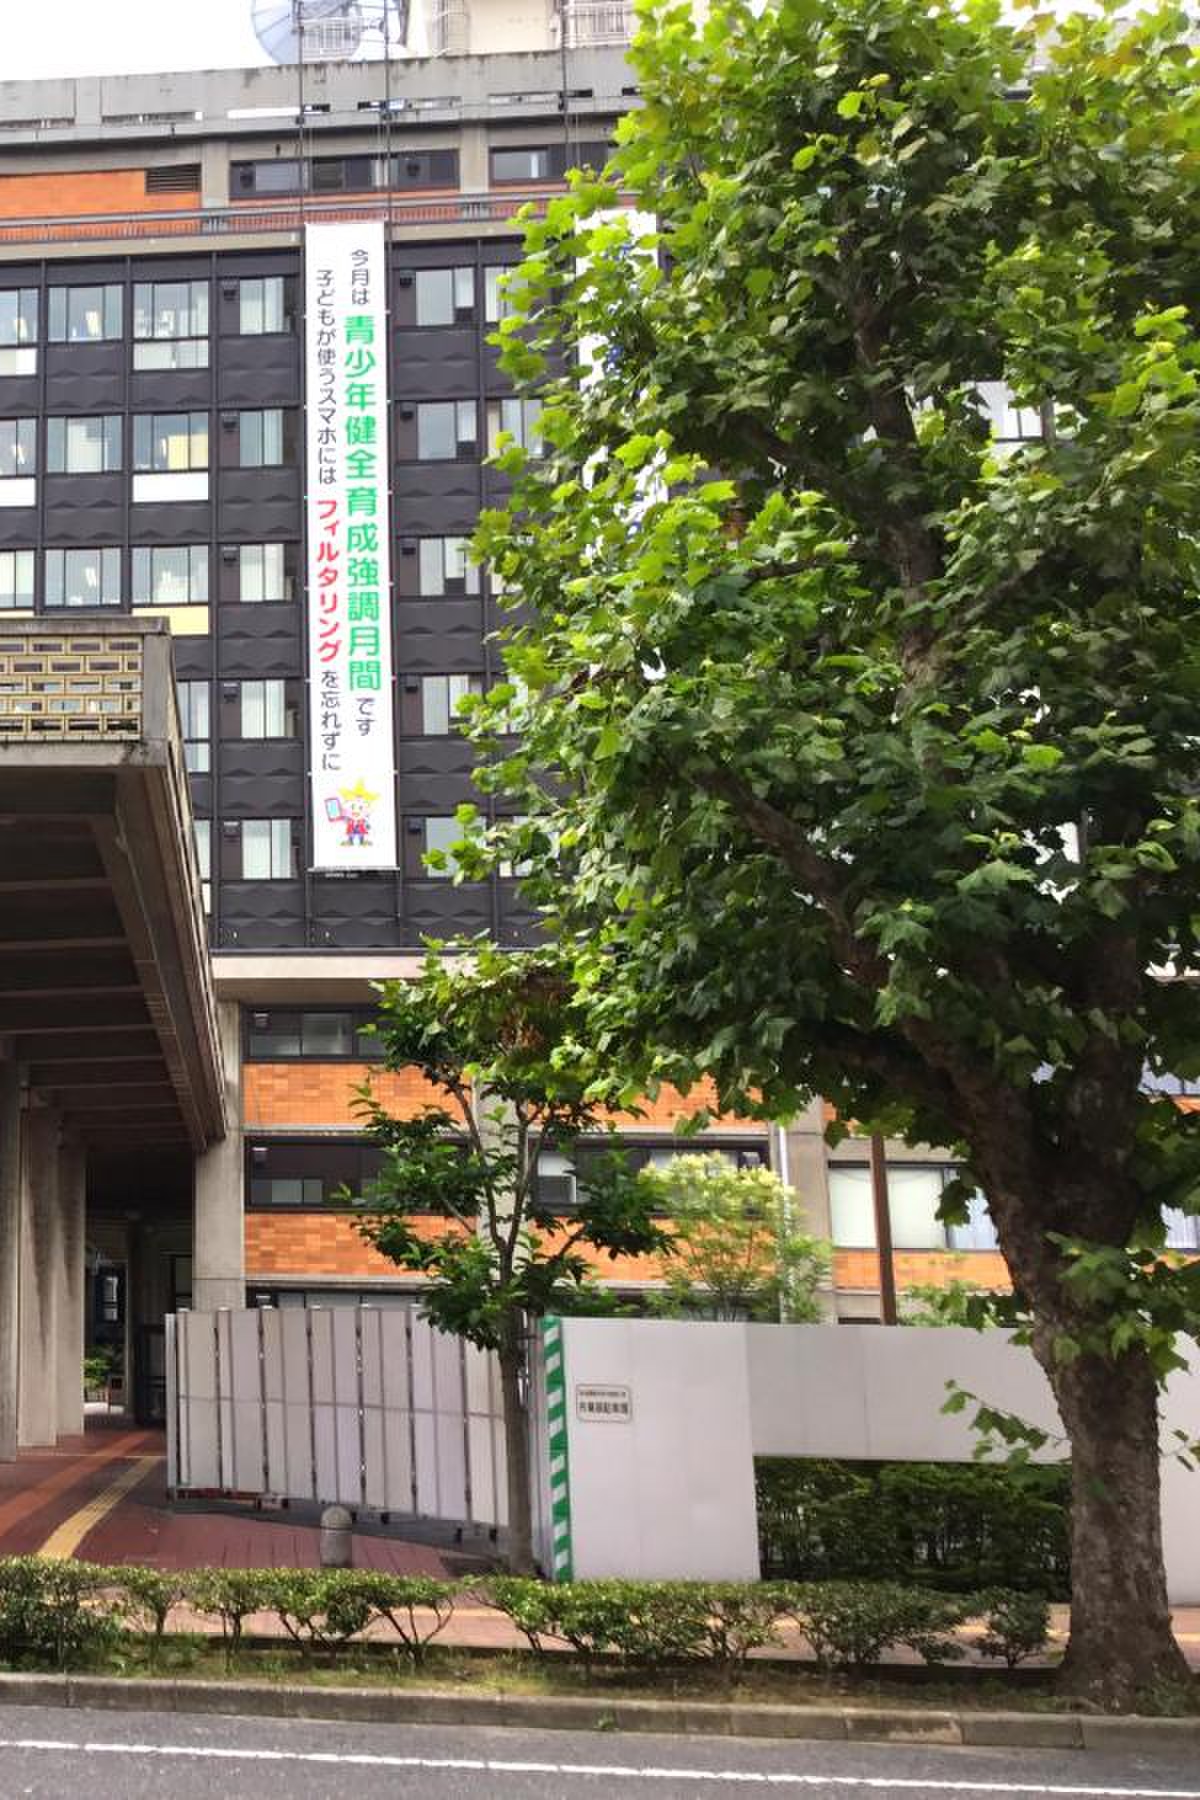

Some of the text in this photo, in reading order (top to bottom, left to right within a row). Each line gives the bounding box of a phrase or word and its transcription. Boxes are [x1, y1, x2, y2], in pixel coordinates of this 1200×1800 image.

[344, 249, 381, 736] 今月は青少年健全育成強調月間です
